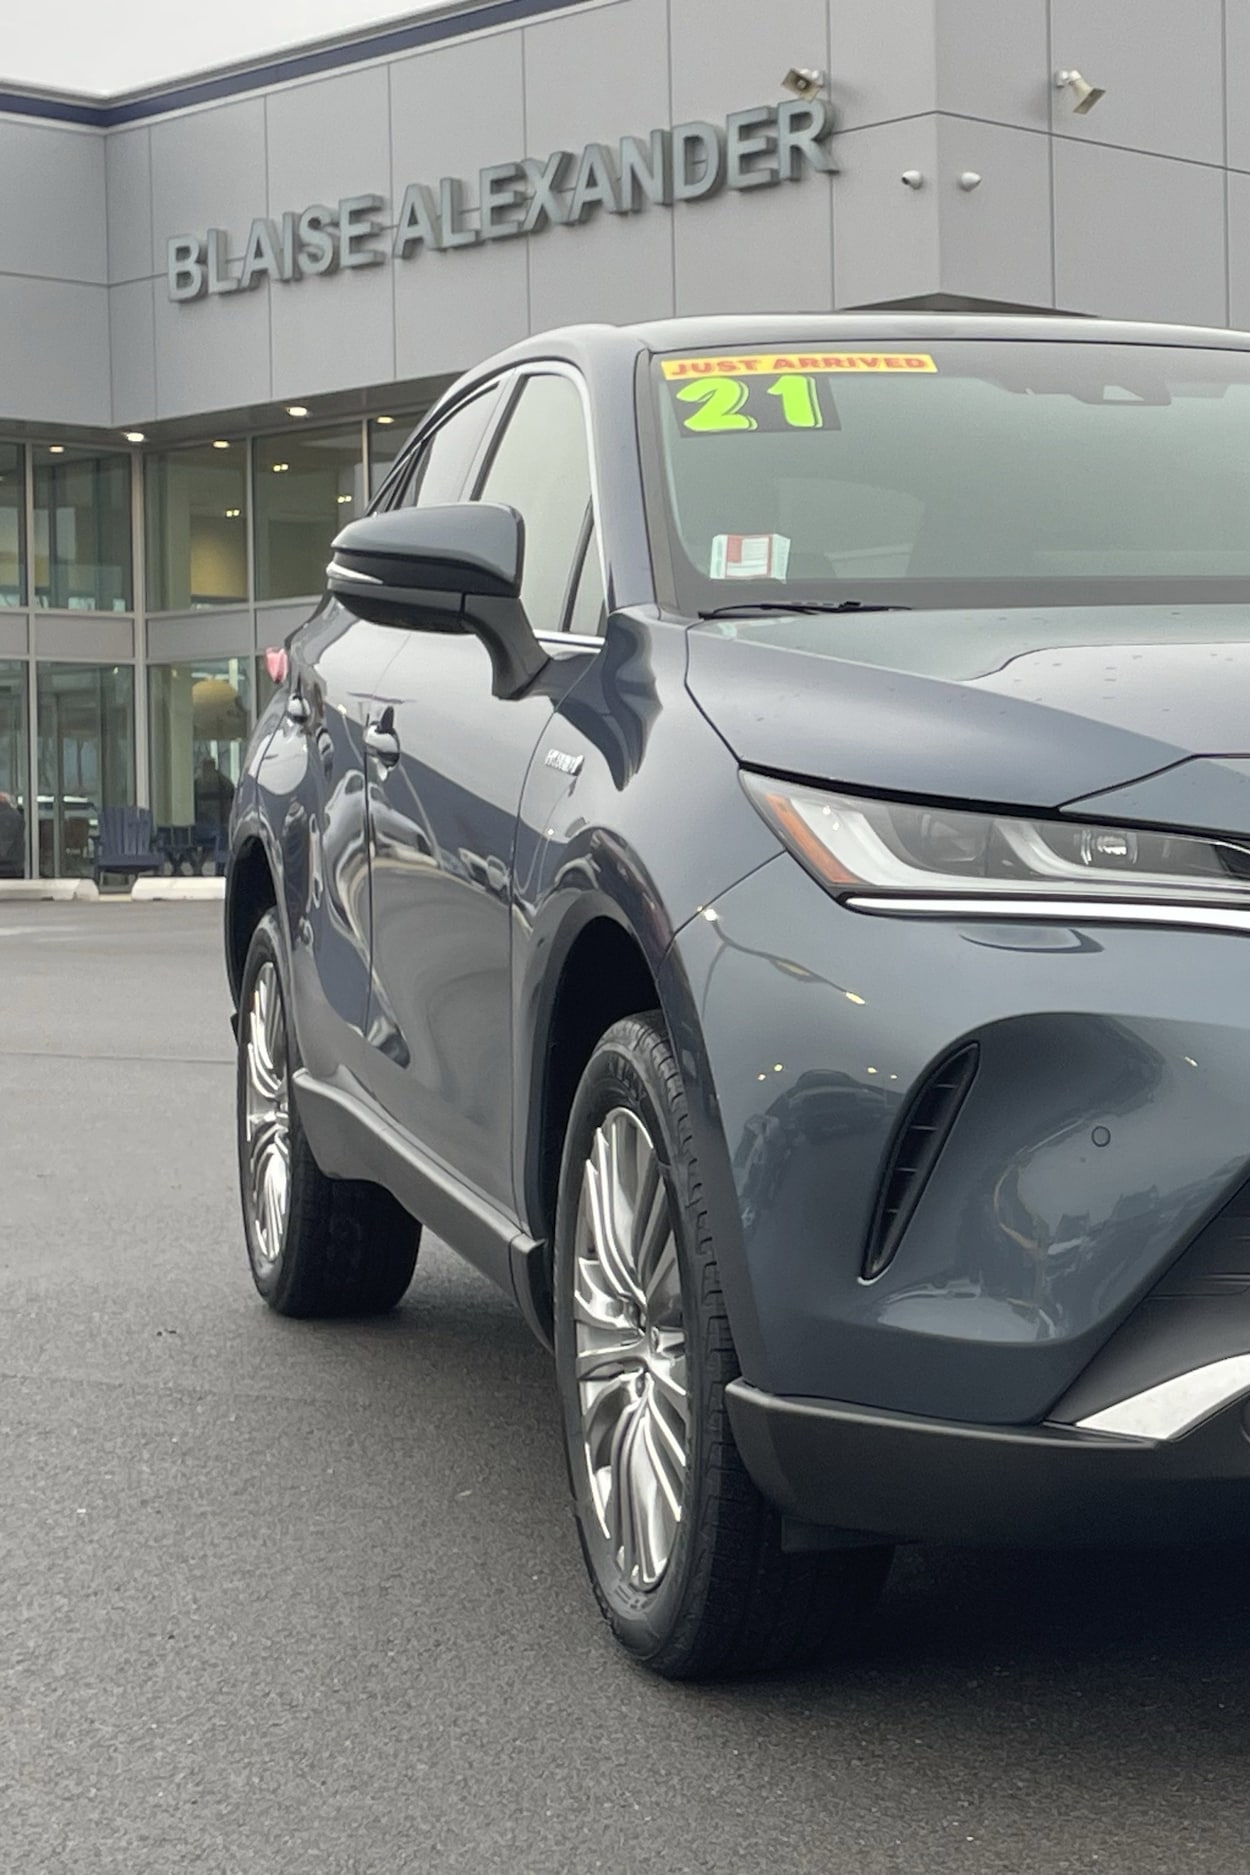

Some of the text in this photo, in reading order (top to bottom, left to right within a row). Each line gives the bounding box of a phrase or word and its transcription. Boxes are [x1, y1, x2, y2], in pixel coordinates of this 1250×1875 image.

[167, 98, 839, 303] BLAISE ALEXANDER
[671, 356, 926, 376] JUST ARRIVED
[676, 375, 823, 432] 21
